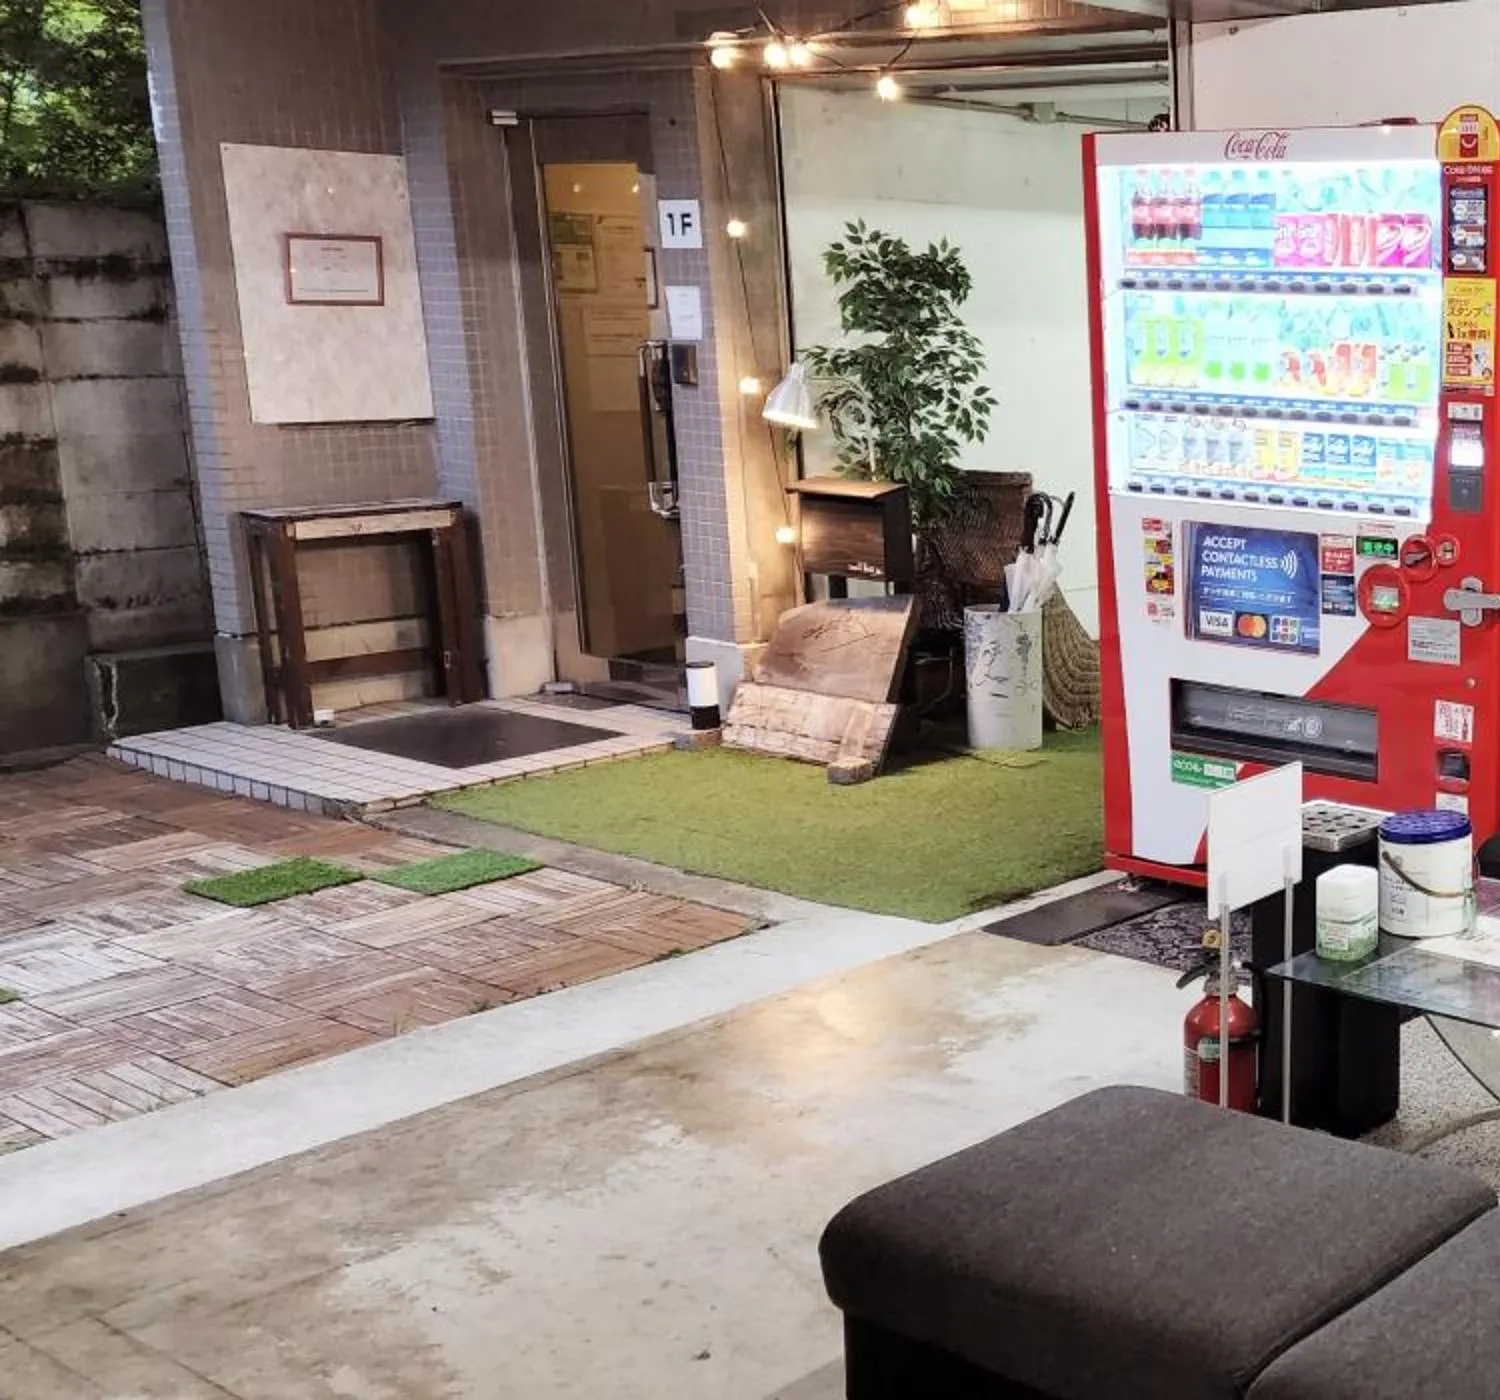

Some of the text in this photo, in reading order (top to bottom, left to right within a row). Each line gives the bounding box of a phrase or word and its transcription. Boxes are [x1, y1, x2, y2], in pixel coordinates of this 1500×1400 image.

[1224, 131, 1286, 160] Coca-Cola
[666, 212, 693, 236] 1F
[1203, 535, 1247, 550] ACCEPT
[1201, 551, 1279, 569] CONTACTLESS
[1201, 566, 1257, 582] PAYMENTS
[1205, 615, 1228, 628] VISA
